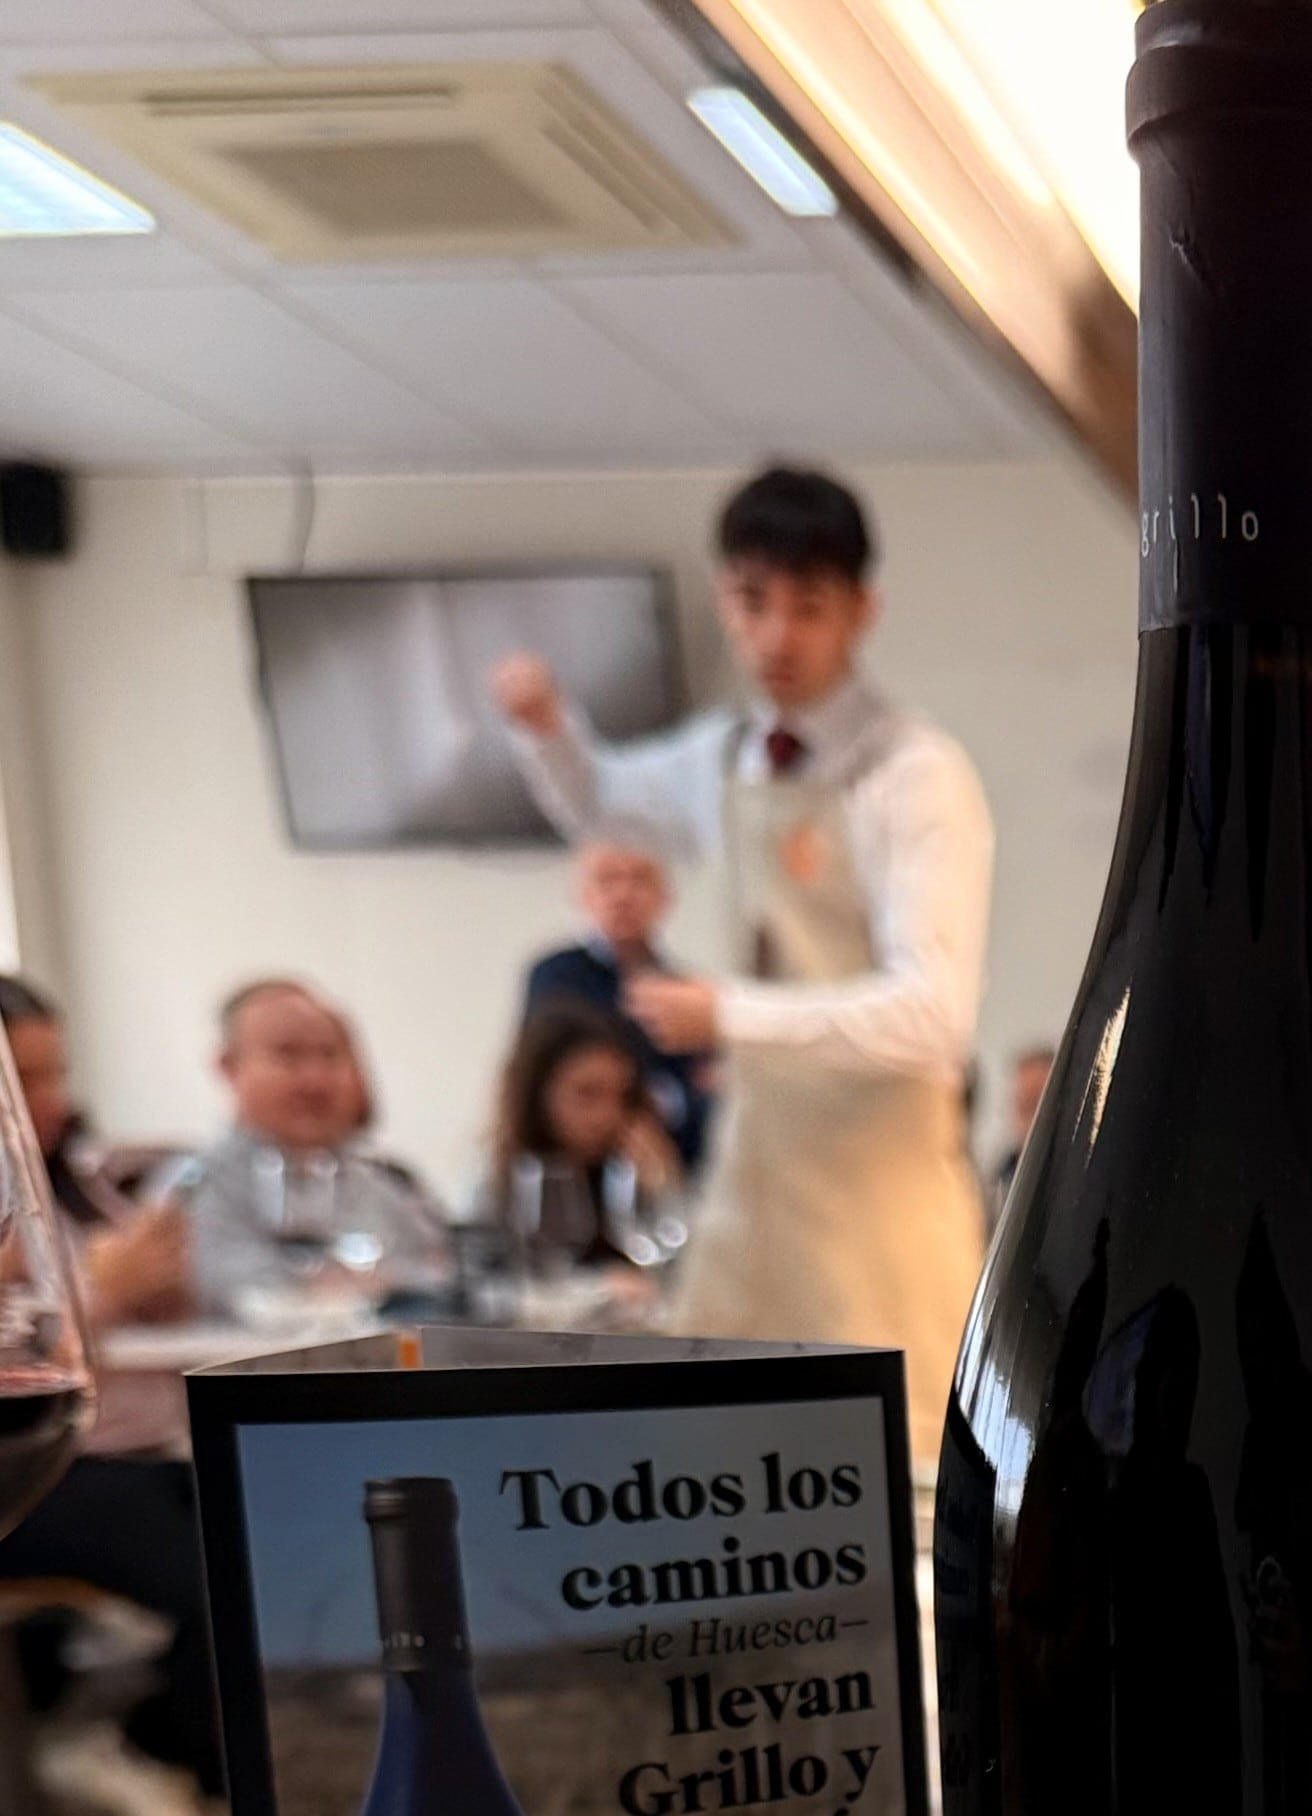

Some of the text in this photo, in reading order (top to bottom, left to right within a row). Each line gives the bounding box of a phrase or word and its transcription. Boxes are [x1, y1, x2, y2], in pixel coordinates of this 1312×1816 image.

[1140, 491, 1259, 558] grillo
[499, 1451, 863, 1531] Todos los
[561, 1536, 868, 1611] caminos
[665, 1671, 877, 1736] llevan
[842, 1745, 882, 1804] y
